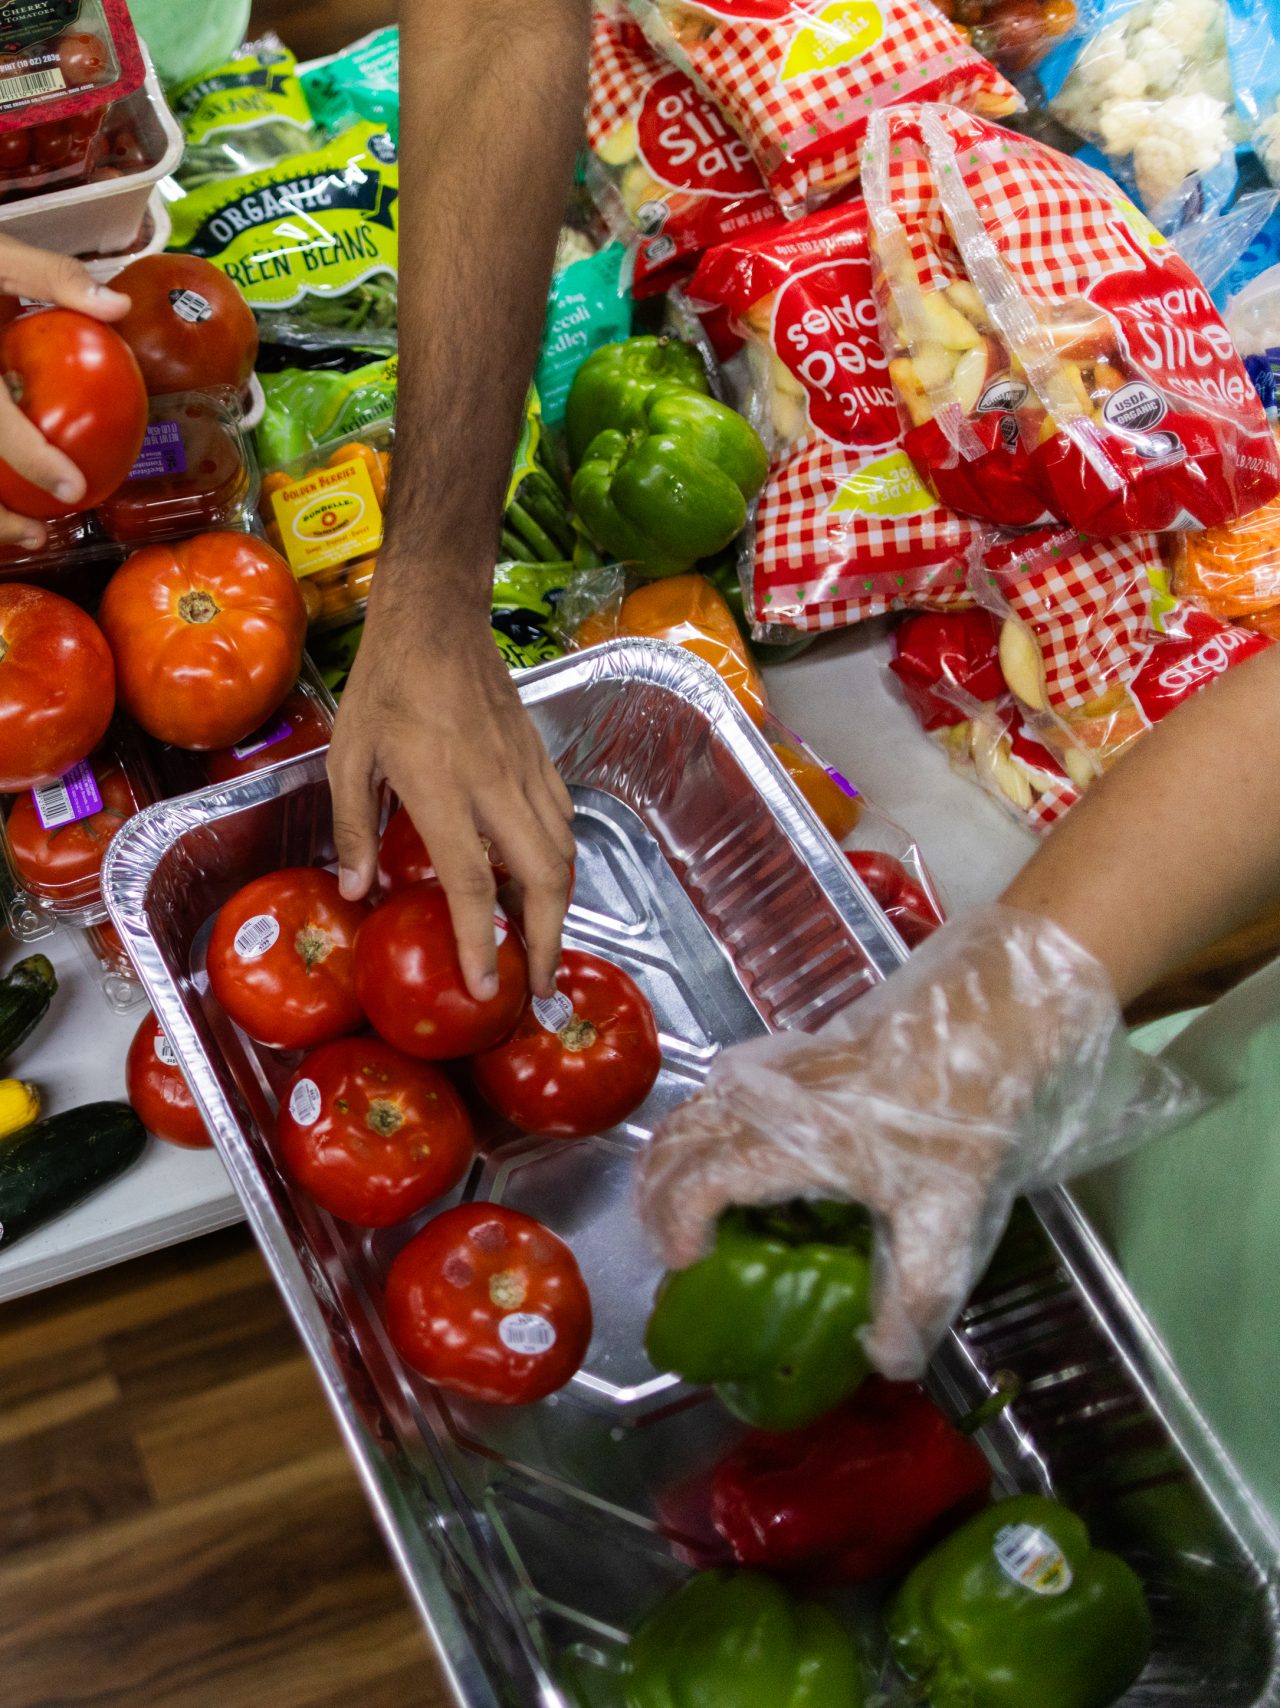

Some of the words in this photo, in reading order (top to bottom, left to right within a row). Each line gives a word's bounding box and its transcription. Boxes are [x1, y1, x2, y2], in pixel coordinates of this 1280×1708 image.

[2, 1, 49, 17] CHERRY
[5, 8, 55, 23] TOMATOES
[209, 175, 332, 243] ORGANIC
[302, 223, 380, 273] BEANS
[1115, 390, 1148, 411] USDA
[1117, 399, 1158, 424] ORGANIC
[282, 484, 317, 502] GOLDEN
[318, 466, 357, 487] BERRIES
